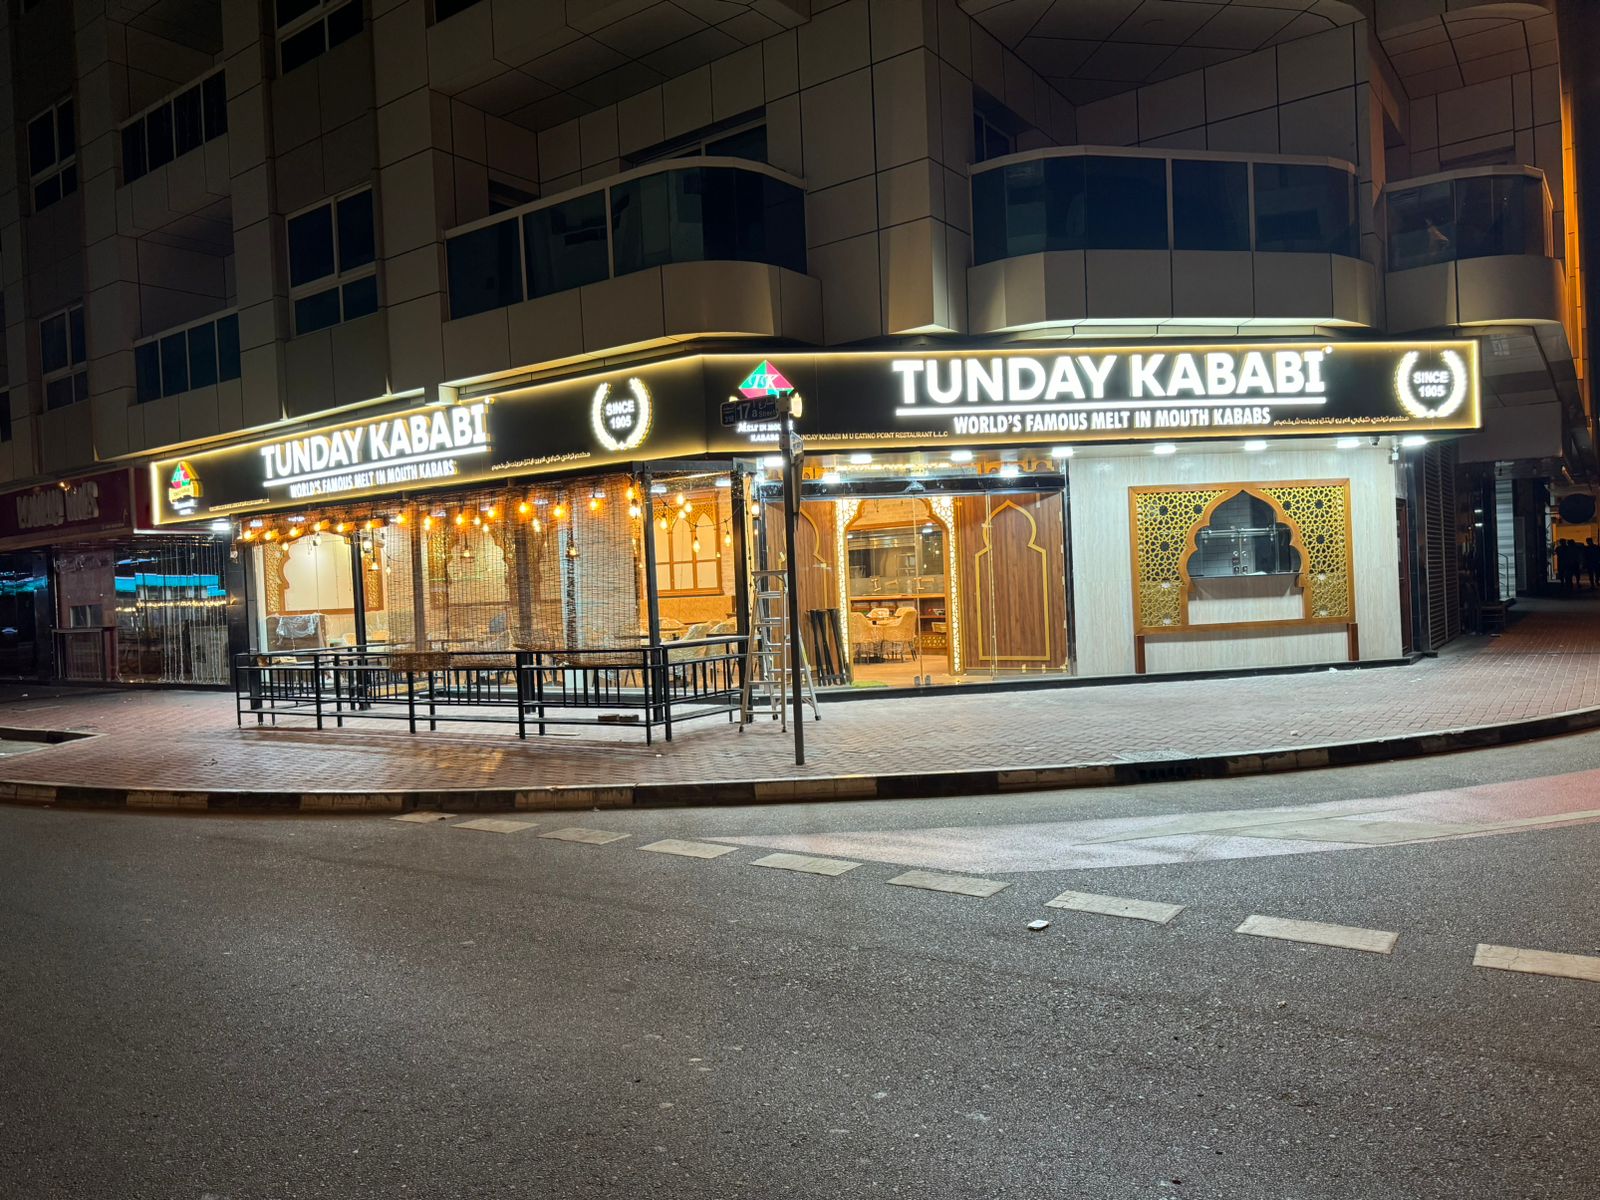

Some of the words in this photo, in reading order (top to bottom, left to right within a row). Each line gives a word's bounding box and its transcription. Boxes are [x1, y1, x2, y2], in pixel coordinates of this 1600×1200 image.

[892, 355, 1118, 404] TUNDAY
[1129, 350, 1326, 398] KABABI
[1413, 370, 1449, 384] SINCE
[1418, 384, 1446, 397] 1905
[605, 399, 635, 416] SINCE
[737, 402, 751, 419] 17
[610, 415, 632, 430] 1905
[953, 414, 1022, 435] WORLD'S
[1025, 412, 1088, 432] FAMOUS
[1091, 410, 1130, 430] MELT
[1134, 409, 1151, 428] IN
[1155, 408, 1209, 428] MOUTH
[1213, 406, 1271, 426] KABABS
[261, 427, 364, 479] TUNDAY
[368, 403, 487, 460] KABABI
[289, 479, 321, 498] WORLD'S
[322, 474, 353, 493] FAMOUS
[355, 471, 375, 489] MELT
[376, 468, 386, 485] IN
[387, 465, 418, 483] MOUTH
[419, 459, 456, 478] KABABS
